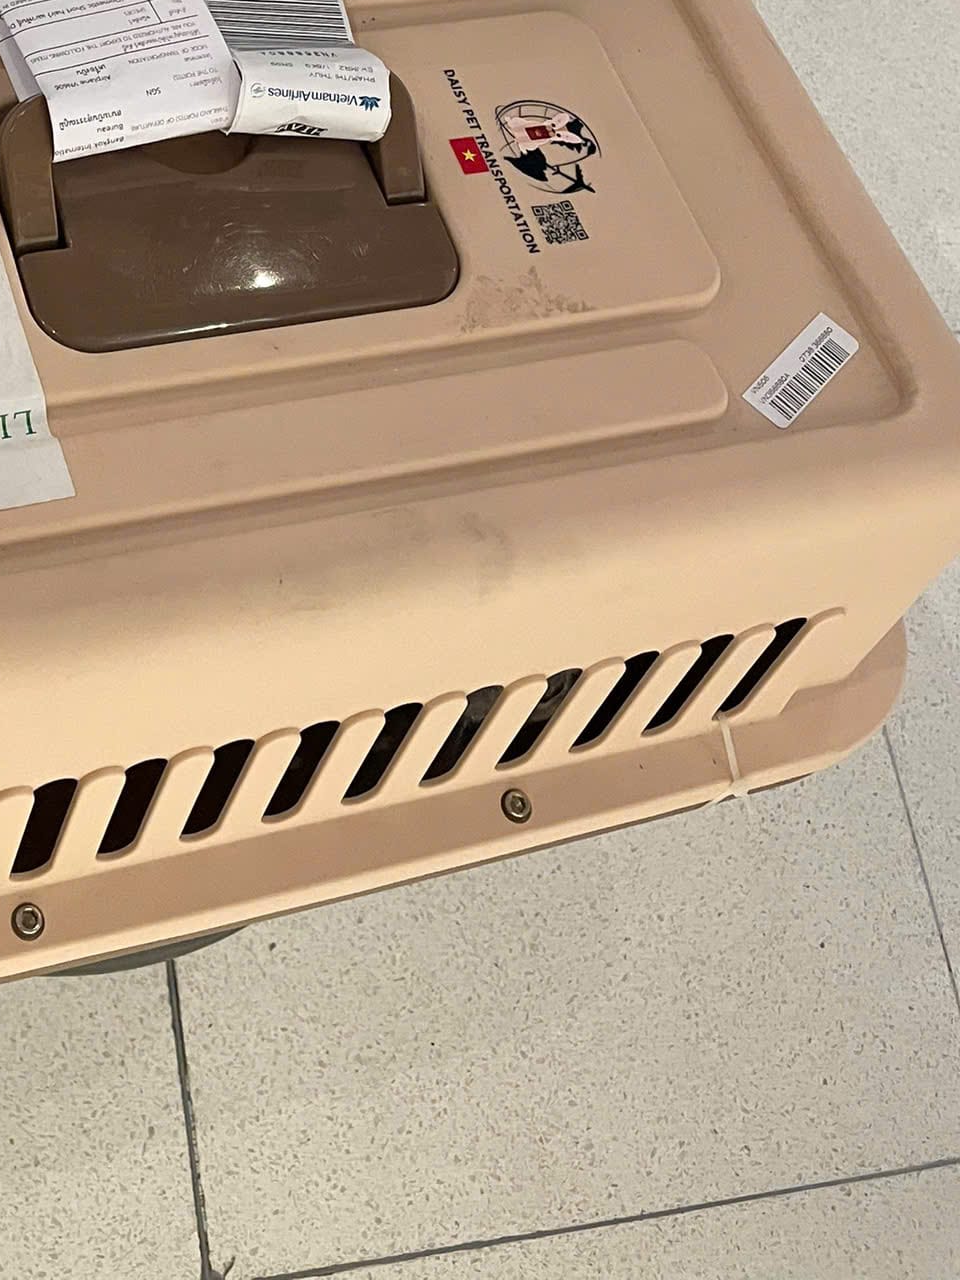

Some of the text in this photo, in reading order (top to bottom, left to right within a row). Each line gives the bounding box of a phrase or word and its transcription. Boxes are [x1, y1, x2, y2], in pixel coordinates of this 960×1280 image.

[145, 86, 161, 96] SGN
[96, 123, 124, 134] Bureau
[442, 66, 541, 256] DAISY PET TRANSPORTATION
